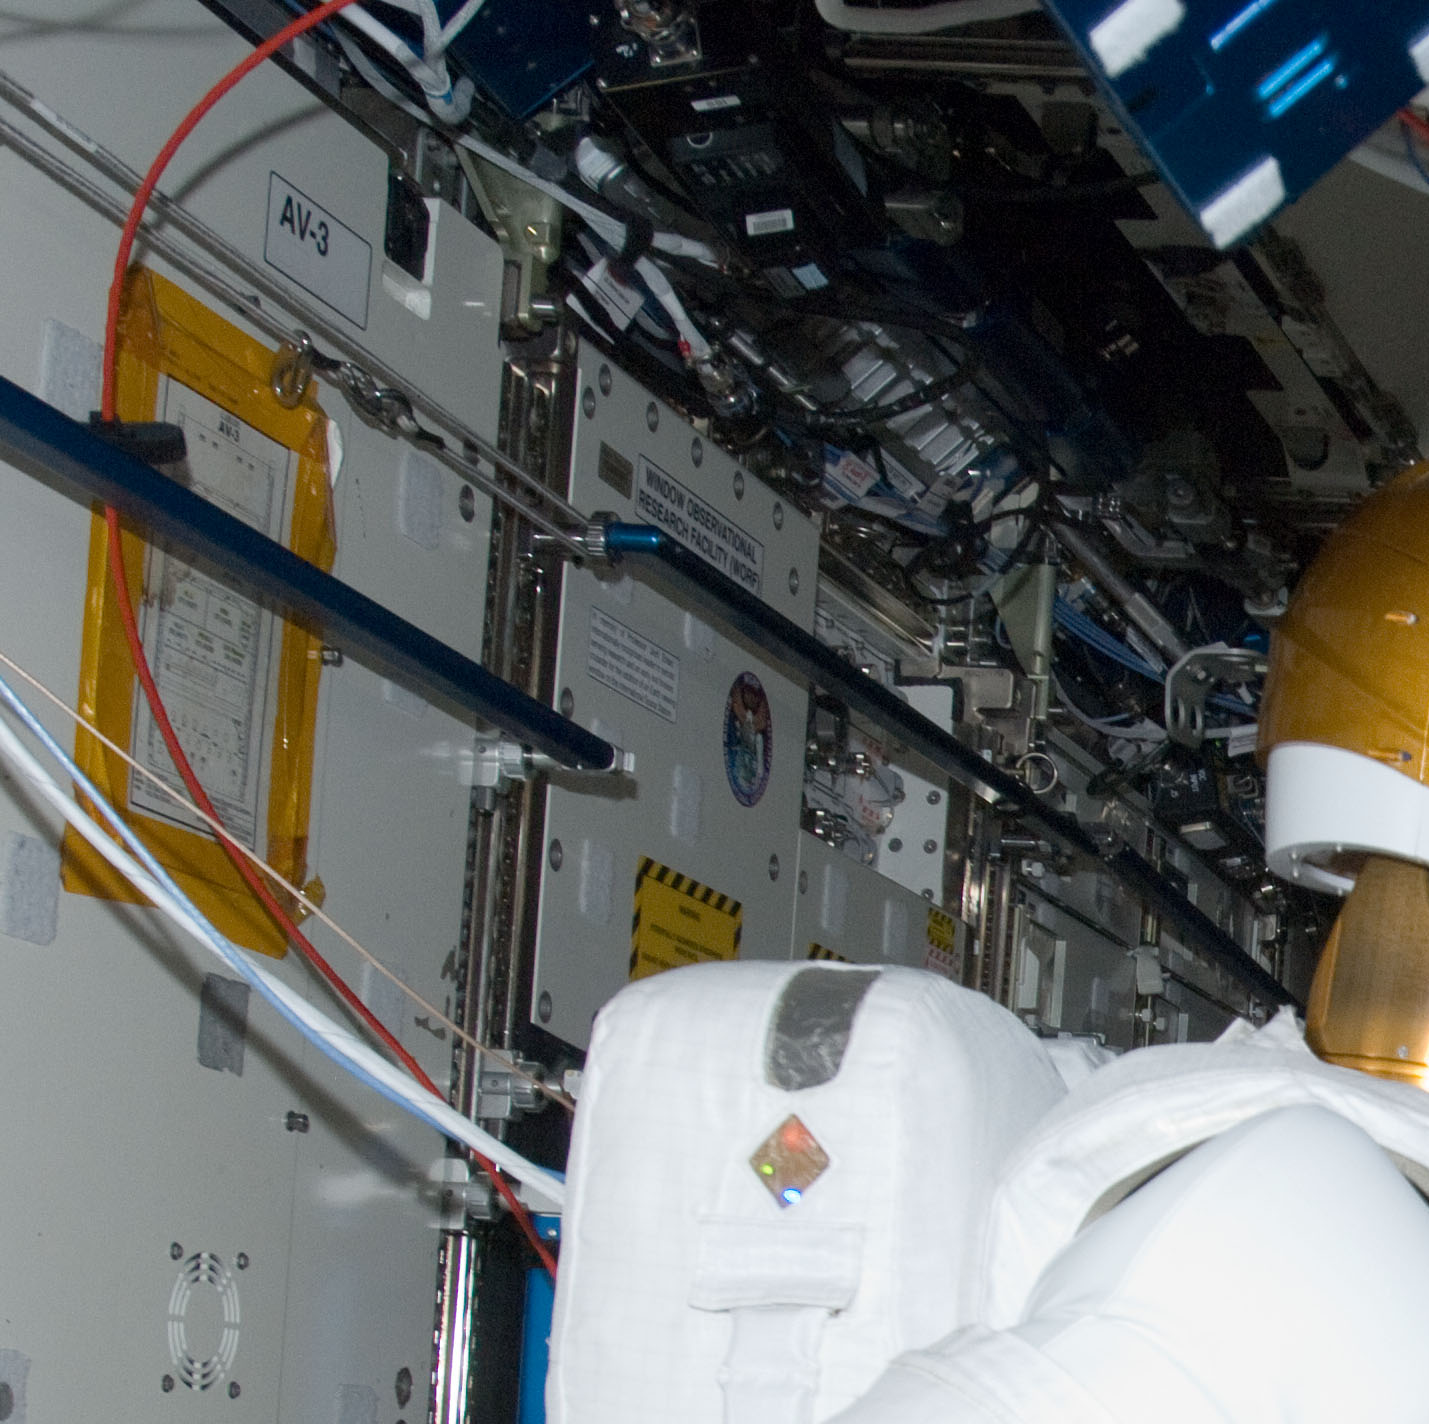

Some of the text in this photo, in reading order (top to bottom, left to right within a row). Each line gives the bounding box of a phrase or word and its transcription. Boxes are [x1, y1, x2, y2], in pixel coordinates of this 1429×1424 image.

[280, 195, 330, 257] AV-3
[218, 420, 241, 443] AV-3
[639, 488, 689, 541] RESEARCH
[691, 526, 729, 570] FACILITY
[646, 465, 757, 565] WINDOW OBSERVATIONAL
